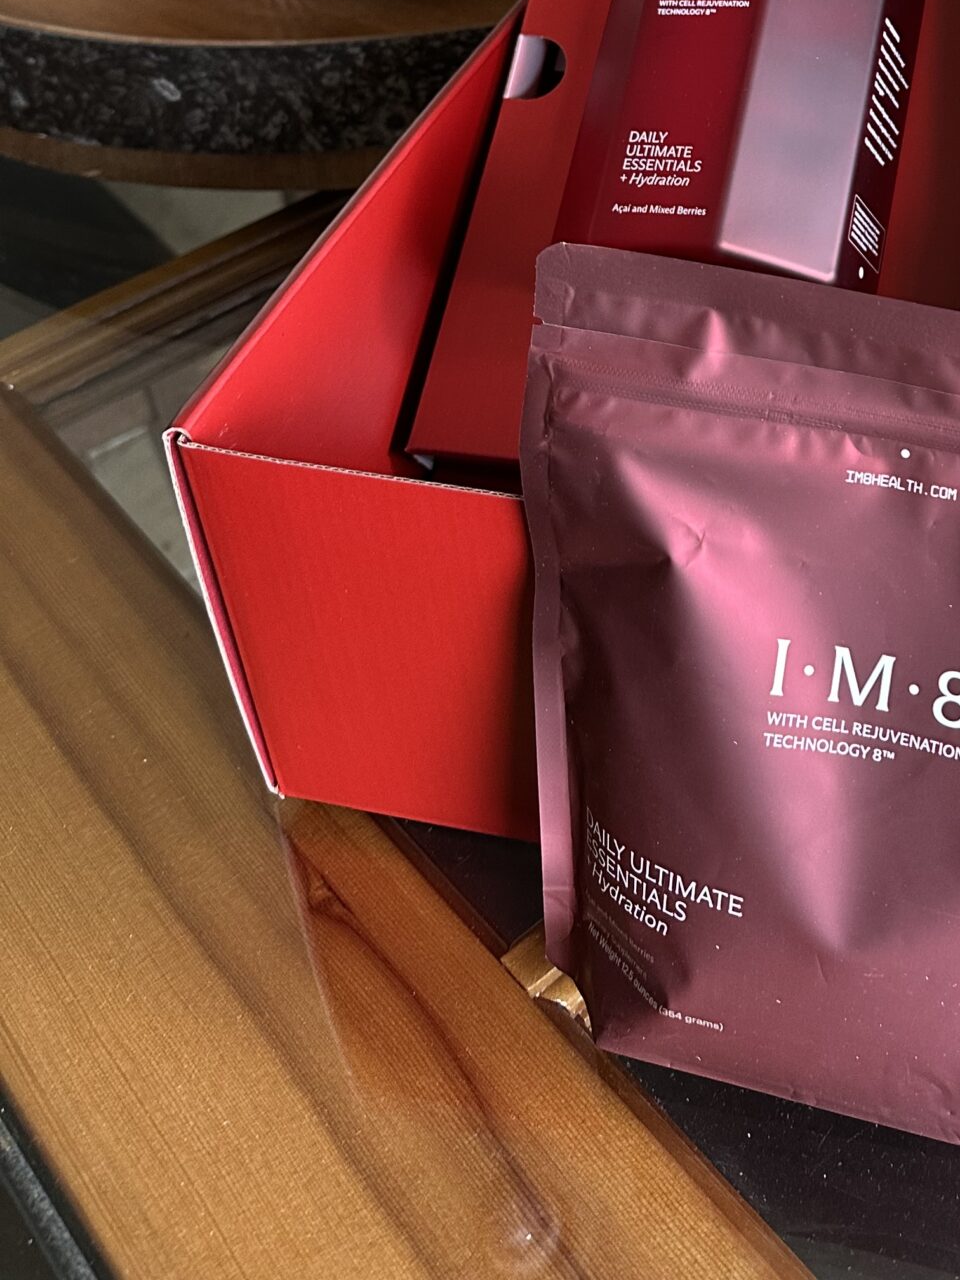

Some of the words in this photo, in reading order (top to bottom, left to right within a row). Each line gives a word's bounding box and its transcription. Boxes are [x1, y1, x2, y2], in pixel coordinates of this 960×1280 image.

[657, 8, 704, 16] TECHNOLOGY
[659, 0, 678, 7] WITH
[679, 0, 696, 7] CELL
[697, 0, 750, 8] REJUVENATION
[628, 130, 668, 143] DAILY
[626, 144, 693, 158] ULTIMATE
[622, 158, 702, 172] ESSENTIALS
[620, 173, 628, 182] +
[629, 172, 690, 188] Hydration
[631, 204, 648, 213] and
[649, 204, 675, 215] Mixed
[676, 205, 707, 216] Berries
[845, 469, 958, 501] IM8HEALTH.COM
[766, 711, 808, 729] WITH
[812, 716, 849, 734] CELL
[763, 732, 871, 759] TECHNOLOGY
[586, 805, 626, 860] DAILY
[630, 851, 744, 918] ULTIMATE
[586, 827, 688, 922] ESSENTIALS
[592, 862, 669, 937] Hydration
[633, 978, 658, 1010] ounces
[684, 1015, 724, 1032] grams)
